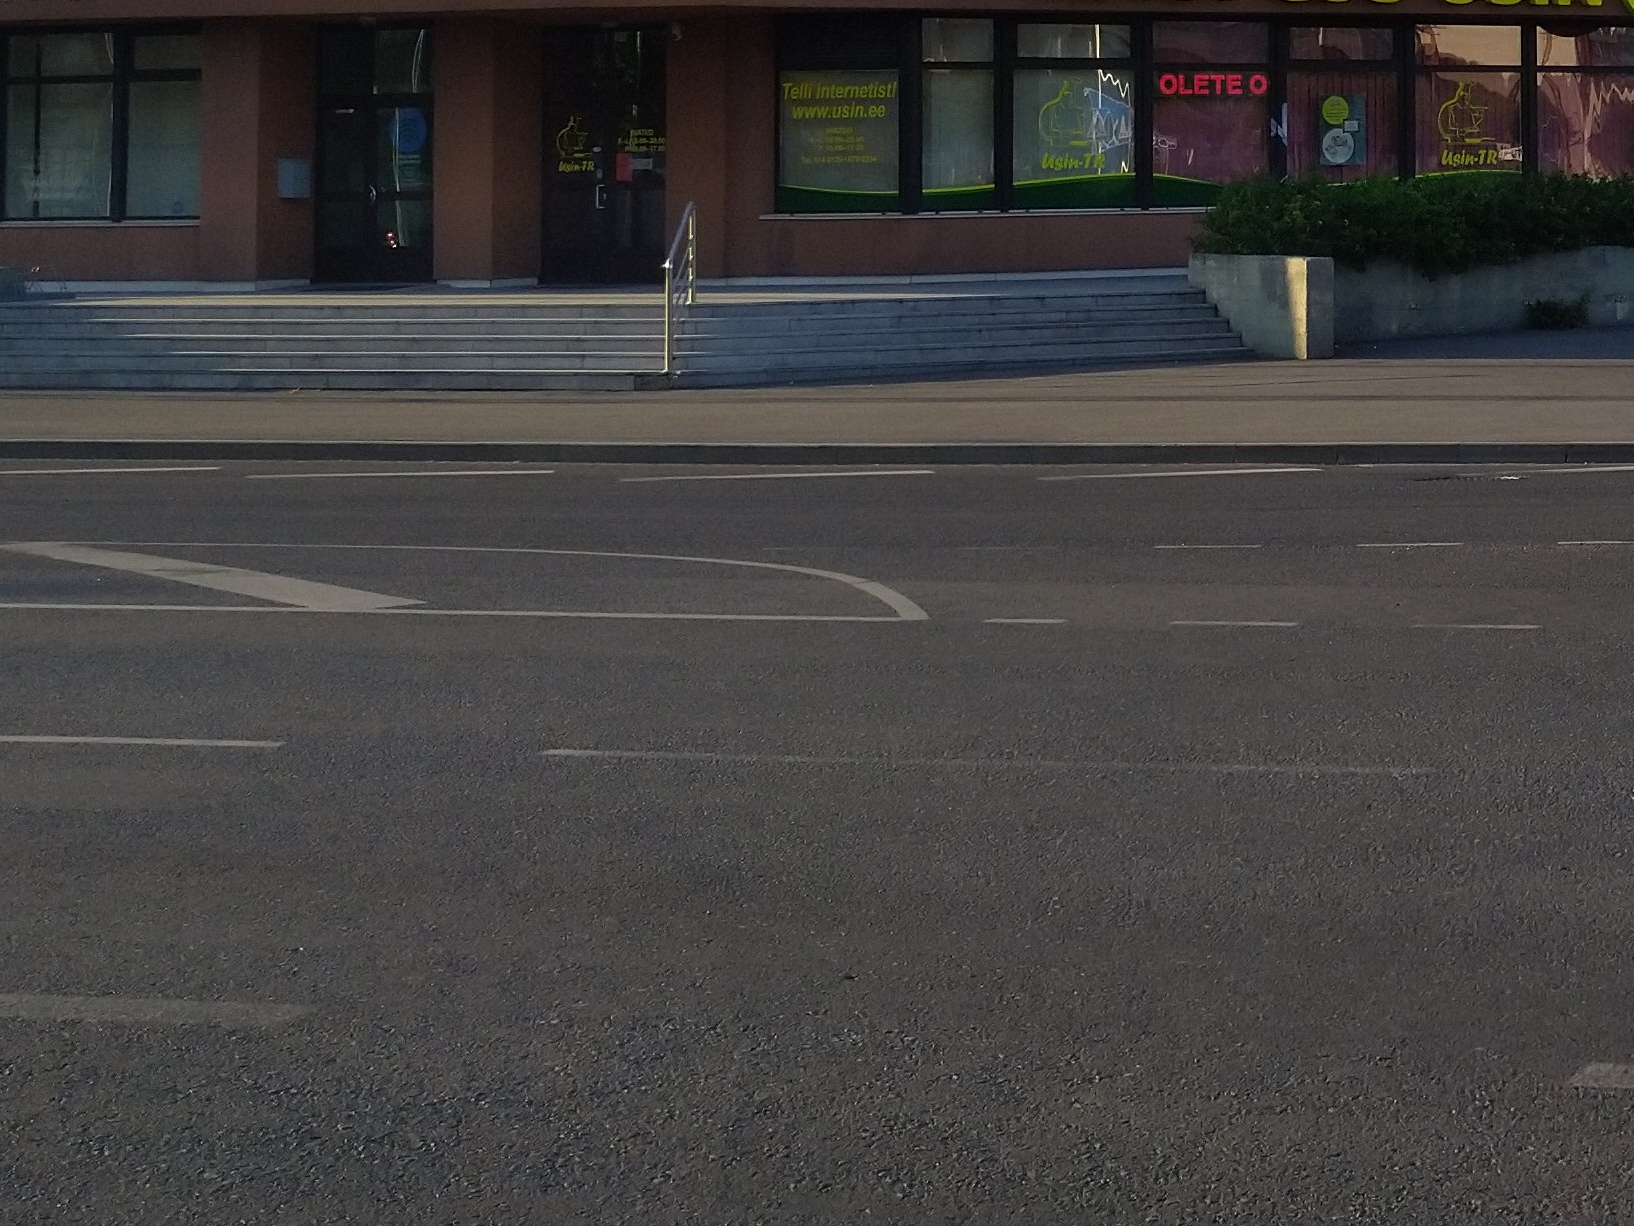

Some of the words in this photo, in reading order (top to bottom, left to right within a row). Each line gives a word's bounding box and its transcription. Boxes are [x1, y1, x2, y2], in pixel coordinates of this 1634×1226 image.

[783, 83, 812, 100] Telli
[1159, 73, 1243, 95] OLETE
[1249, 74, 1268, 95] O
[792, 102, 886, 119] www.usin.ee
[1441, 149, 1498, 168] Usin-TR
